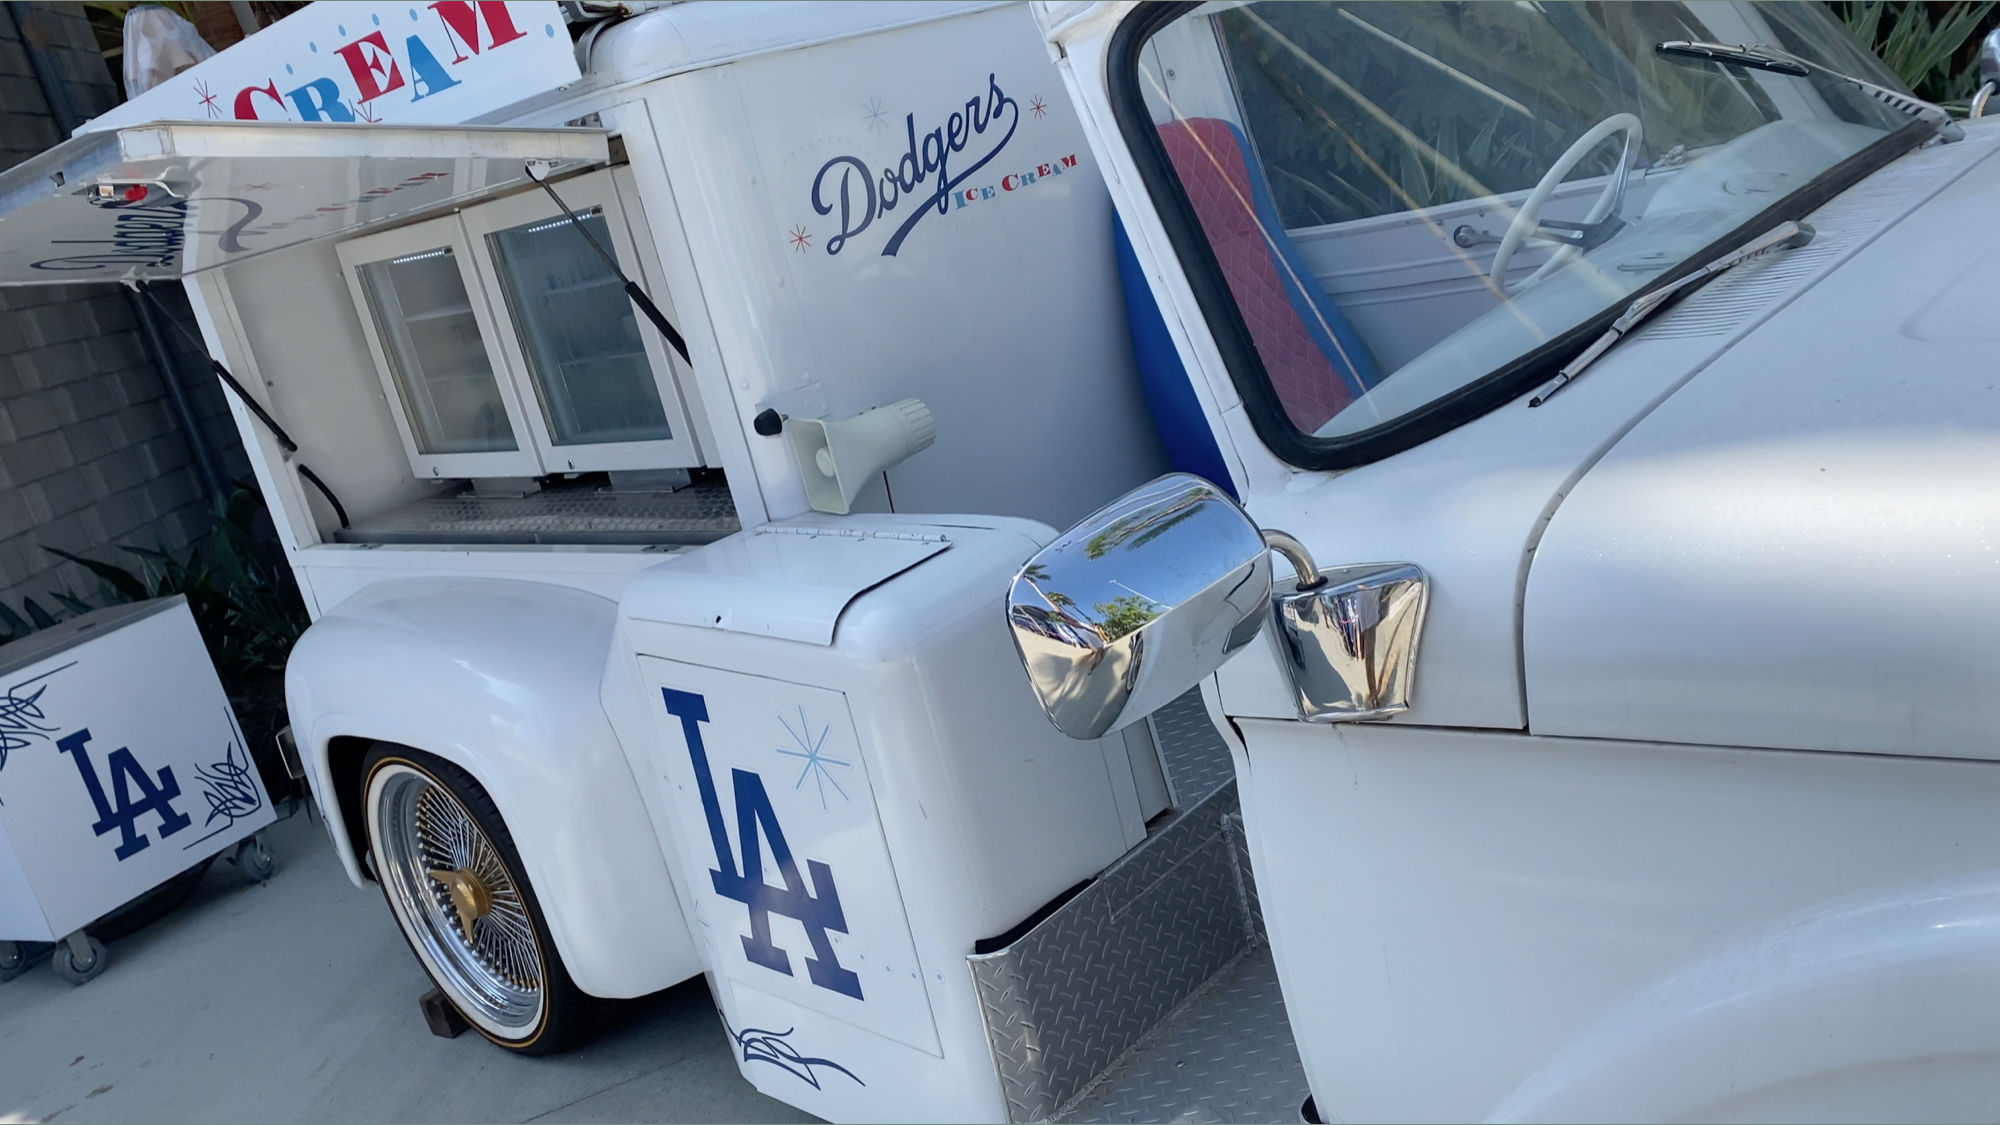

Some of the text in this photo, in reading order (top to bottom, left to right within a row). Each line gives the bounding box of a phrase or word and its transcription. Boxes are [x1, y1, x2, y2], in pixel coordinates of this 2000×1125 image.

[811, 72, 1019, 257] Dodgers
[953, 154, 1078, 209] ICE CREAM
[56, 727, 192, 862] LA
[660, 686, 865, 1002] LA
